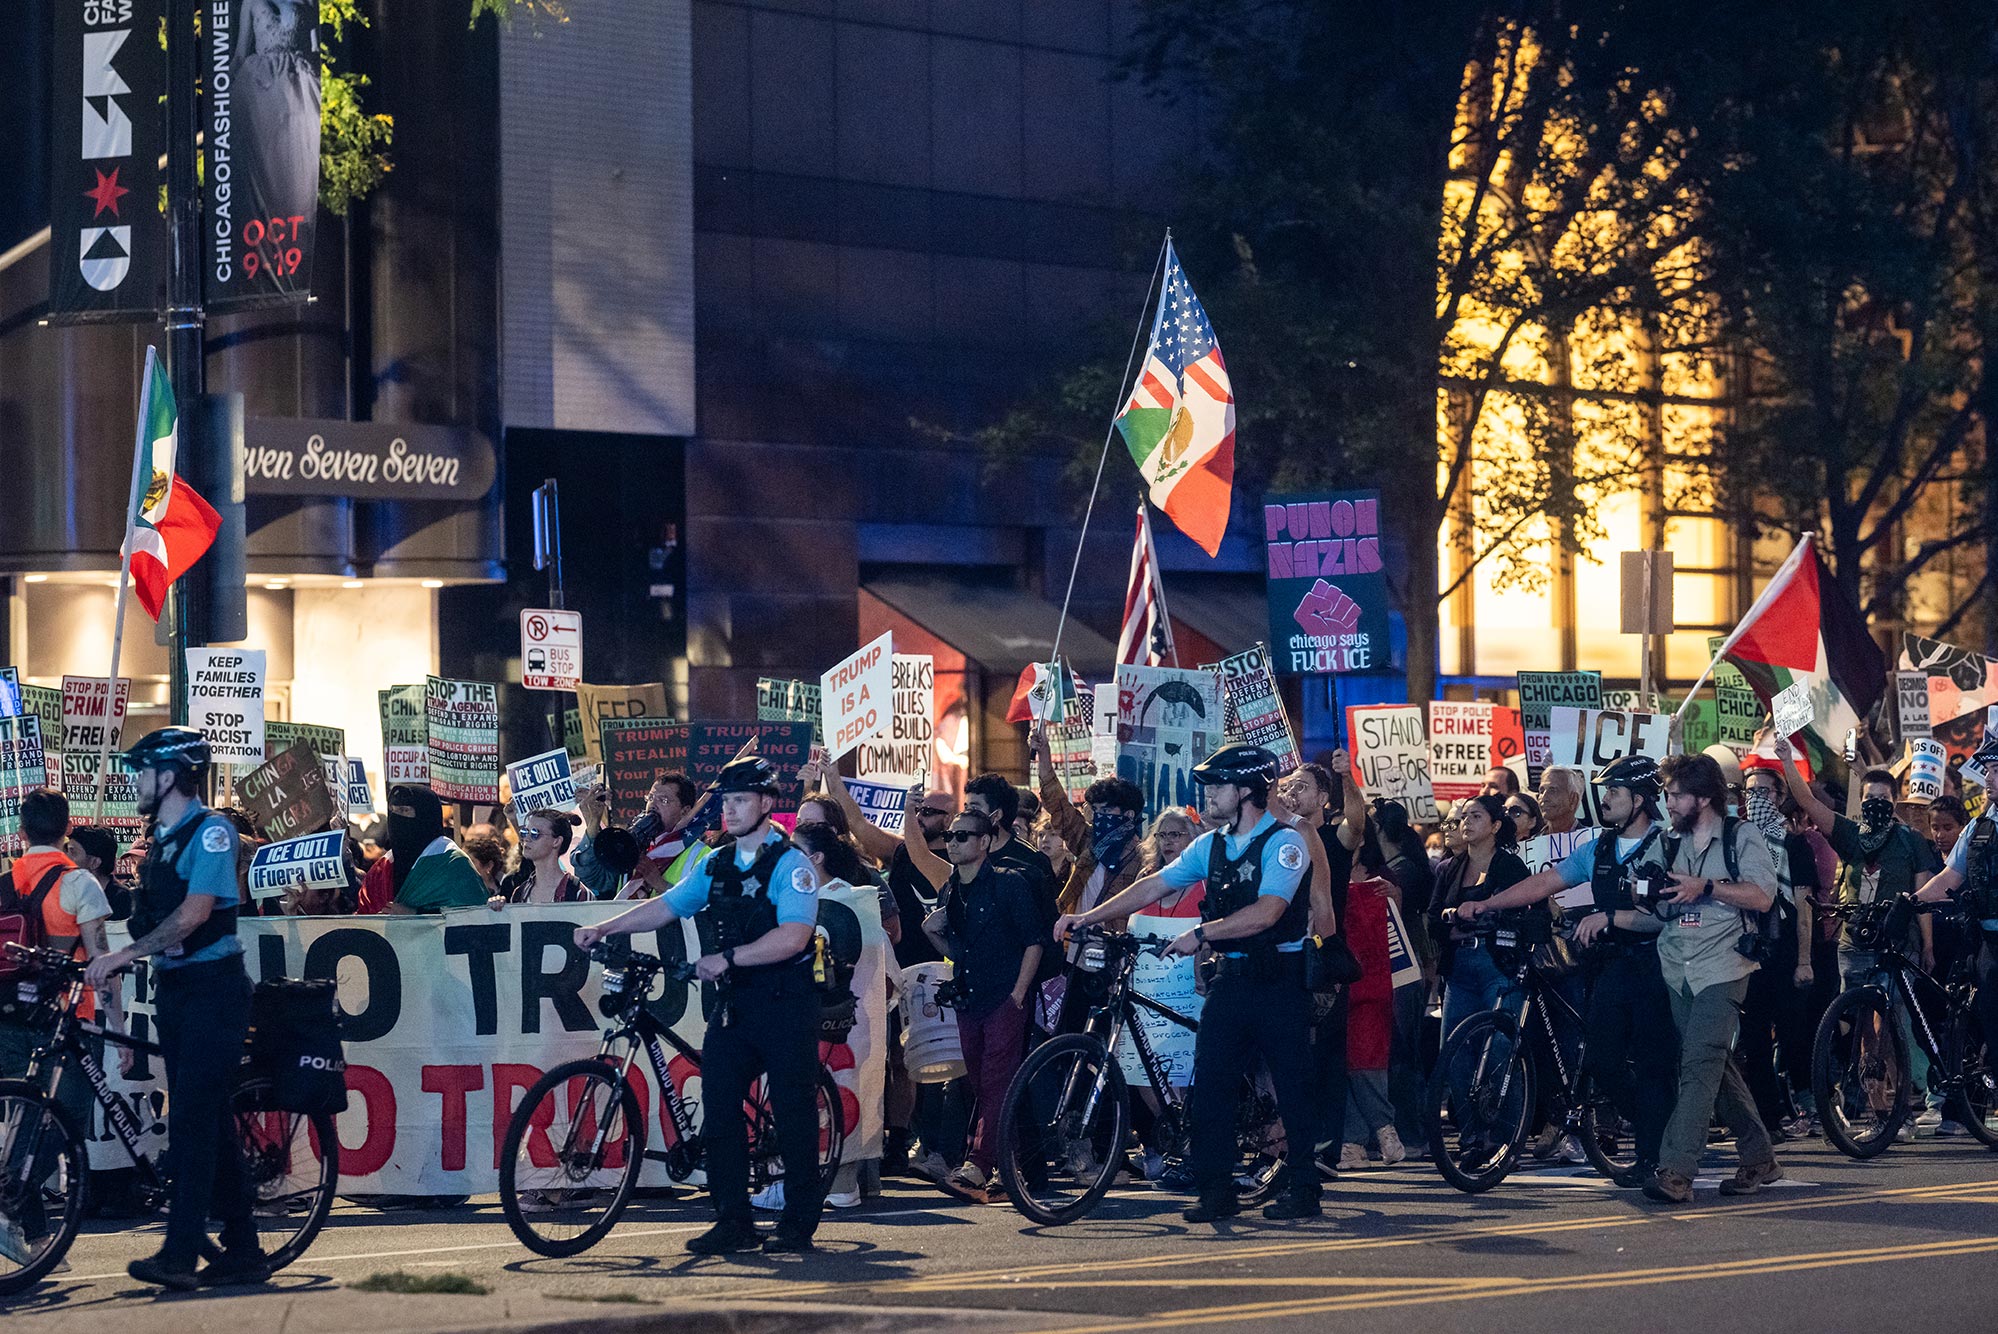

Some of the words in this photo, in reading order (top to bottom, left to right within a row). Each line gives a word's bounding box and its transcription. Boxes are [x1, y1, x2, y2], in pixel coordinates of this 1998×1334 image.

[243, 215, 304, 246] OCT
[300, 434, 378, 483] Seven
[383, 437, 460, 486] Seven
[1265, 499, 1378, 540] PUNCH
[1268, 537, 1384, 579] NAZIS
[1290, 633, 1336, 649] chicago
[1339, 632, 1370, 648] says
[208, 656, 243, 668] KEEP
[550, 648, 569, 660] BUS
[1291, 651, 1338, 671] FUCK
[1343, 648, 1371, 669] ICE
[550, 662, 574, 674] STOP
[829, 646, 882, 692] TRUMP
[892, 662, 932, 690] BREAKS
[196, 670, 256, 683] FAMILIES
[527, 675, 549, 687] TOW
[554, 677, 577, 689] ZONE
[1228, 669, 1266, 690] TRUMP
[1521, 675, 1543, 683] FROM
[65, 682, 91, 694] STOP
[191, 685, 261, 698] TOGETHER
[428, 679, 457, 701] STOP
[462, 684, 493, 702] THE
[1231, 681, 1269, 699] DEFEND
[1522, 685, 1598, 702] CHICAGO
[1719, 690, 1738, 699] FROM
[63, 695, 125, 717] CRIMS
[451, 702, 495, 713] AGENDA!
[841, 693, 855, 716] IS
[859, 684, 871, 705] A
[1900, 692, 1929, 708] NO
[462, 713, 498, 721] EXPAND
[1433, 706, 1457, 716] STOP
[205, 712, 244, 728] STOP
[603, 721, 625, 730] FROM
[893, 715, 932, 741] BUILD
[1243, 717, 1265, 730] STOP
[52, 723, 60, 734] TO
[199, 728, 252, 744] RACIST
[267, 725, 290, 734] FROM
[615, 728, 690, 742] TRUMP'S
[704, 726, 792, 737] TRUMP'S
[836, 709, 877, 749] PEDO
[1245, 724, 1277, 740] DEFEND
[1362, 715, 1425, 749] STAND
[1574, 709, 1652, 767] ICE
[211, 745, 262, 756] ORTATION
[442, 742, 464, 751] POLICE
[467, 745, 498, 753] CRIMES
[1445, 744, 1486, 759] FREE
[482, 754, 498, 762] AND
[1529, 751, 1541, 763] IS
[390, 766, 400, 778] IS
[403, 766, 410, 777] A
[470, 762, 498, 770] RIGHTS
[515, 766, 534, 789] ICE
[535, 758, 560, 782] OUT!
[1362, 755, 1393, 788] UP
[1397, 753, 1431, 787] FOR
[1433, 763, 1467, 775] THEM
[66, 774, 94, 785] TRUMP
[615, 769, 649, 780] Your
[67, 785, 94, 793] DEFEND
[448, 783, 490, 793] EDUCATION
[460, 790, 498, 801] FREEDOM
[551, 779, 575, 803] ICE!
[113, 793, 139, 801] RIGHT
[268, 786, 287, 808] LA
[849, 784, 870, 806] ICE
[874, 787, 903, 810] OUT!
[879, 813, 904, 831] ICE!
[266, 844, 292, 863] ICE
[293, 838, 329, 859] OUT!
[309, 859, 341, 882] ICE!
[1133, 1012, 1153, 1056] CHICAGO
[1150, 1056, 1168, 1094] POLICE
[650, 1040, 673, 1088] CHICAGO
[667, 1089, 686, 1130] POLICE
[80, 1054, 114, 1104] CHICAGO
[109, 1103, 138, 1146] POLICE
